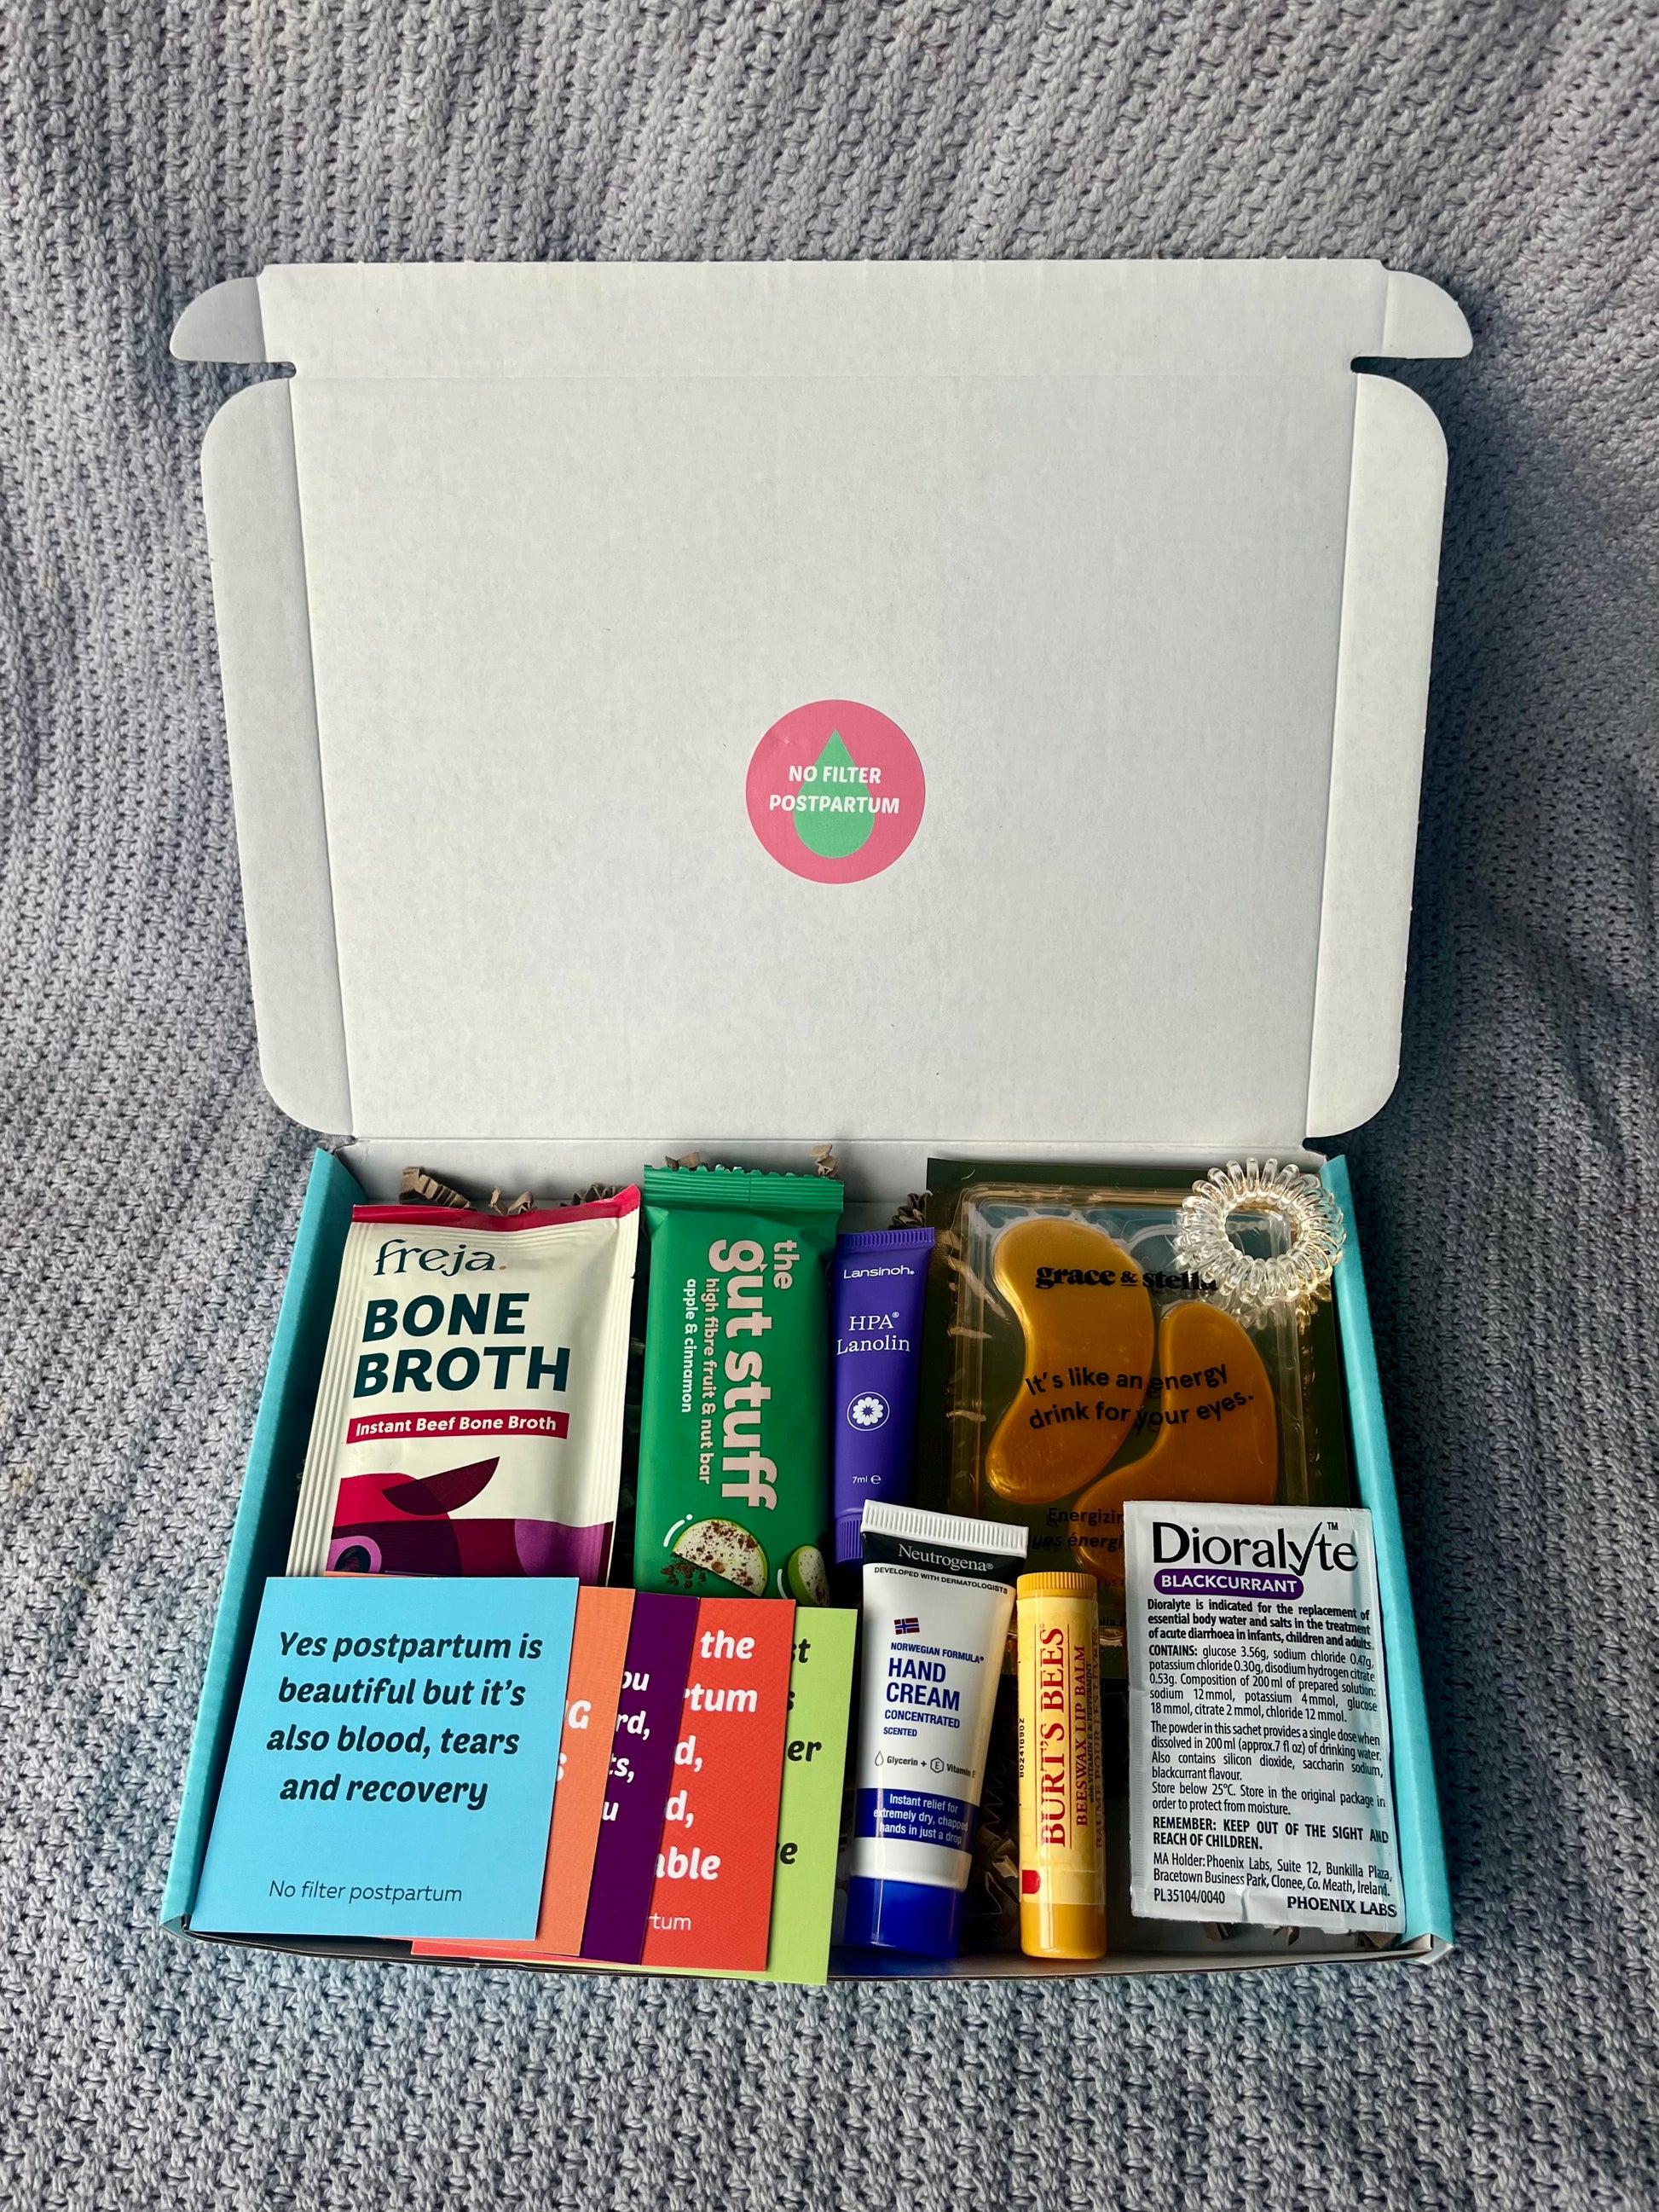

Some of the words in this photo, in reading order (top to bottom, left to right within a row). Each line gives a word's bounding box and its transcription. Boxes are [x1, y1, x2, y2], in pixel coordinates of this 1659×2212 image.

[789, 766, 817, 782] NO
[823, 766, 882, 784] FILTER
[769, 794, 899, 814] POSTPARTUM
[773, 1240, 800, 1289] the
[708, 1239, 772, 1339] gut
[1035, 1266, 1115, 1289] grace
[1120, 1271, 1137, 1287] &
[1142, 1271, 1219, 1291] stella
[682, 1278, 698, 1320] apple
[699, 1278, 720, 1313] high
[362, 1293, 529, 1343] BONE
[685, 1323, 697, 1334] &
[702, 1316, 720, 1357] fibre
[836, 1335, 910, 1356] Lanolin
[353, 1346, 570, 1398] BROTH
[682, 1337, 697, 1413] cinnamon
[702, 1359, 718, 1398] fruit
[1025, 1371, 1063, 1396] It's
[1068, 1367, 1109, 1387] like
[1116, 1373, 1142, 1389] an
[1151, 1364, 1228, 1392] energy
[701, 1403, 716, 1416] &
[1029, 1402, 1090, 1429] drink
[1095, 1401, 1130, 1422] for
[1136, 1408, 1188, 1429] your
[1197, 1391, 1253, 1421] eyes.
[356, 1421, 412, 1437] Instant
[416, 1417, 455, 1432] Beef
[460, 1416, 503, 1430] Bone
[508, 1416, 557, 1431] Broth
[699, 1419, 714, 1450] nut
[721, 1350, 777, 1511] stuff
[699, 1454, 714, 1485] bar
[853, 1475, 868, 1484] 7ml
[875, 1566, 919, 1578] DEVELOPED
[941, 1577, 1008, 1594] DERMATOLOGISTS
[1161, 1574, 1297, 1593] BLACKCURRANT
[1147, 1599, 1190, 1611] Dioralyte
[1195, 1600, 1204, 1610] is
[1209, 1600, 1252, 1612] indicated
[1257, 1602, 1272, 1613] for
[1277, 1603, 1292, 1614] the
[1298, 1607, 1356, 1619] replacement
[1361, 1610, 1369, 1620] of
[1147, 1613, 1189, 1624] essential
[1193, 1613, 1217, 1627] body
[1219, 1617, 1246, 1625] water
[1250, 1617, 1267, 1627] and
[1270, 1617, 1292, 1628] salts
[1295, 1618, 1304, 1629] in
[1307, 1618, 1323, 1630] the
[1326, 1621, 1370, 1635] treatment
[280, 1631, 327, 1656] Yes
[332, 1634, 511, 1663] postpartum
[518, 1633, 543, 1659] is
[701, 1630, 754, 1659] the
[891, 1642, 939, 1655] NORWEGIAN
[1148, 1628, 1159, 1638] of
[1159, 1629, 1186, 1639] acute
[1188, 1629, 1234, 1639] diarrhoea
[1237, 1630, 1246, 1640] in
[1247, 1630, 1284, 1642] infants,
[1286, 1632, 1323, 1644] children
[1327, 1635, 1344, 1646] and
[1345, 1636, 1374, 1651] adults.
[888, 1658, 946, 1682] HAND
[1149, 1645, 1197, 1656] CONTAINS:
[1203, 1645, 1236, 1659] glucose
[1241, 1647, 1269, 1660] 3.56g,
[1274, 1648, 1306, 1660] sodium
[1311, 1650, 1346, 1663] chloride
[1350, 1653, 1373, 1669] 0.47g,
[1074, 1645, 1085, 1698] BALM
[278, 1677, 416, 1705] beautiful
[423, 1679, 476, 1705] but
[480, 1679, 526, 1706] it's
[887, 1682, 960, 1711] CREAM
[885, 1710, 960, 1728] CONCENTRATED
[1075, 1702, 1086, 1732] LIP
[267, 1724, 329, 1751] also
[337, 1725, 431, 1759] blood,
[441, 1728, 520, 1755] tears
[883, 1727, 917, 1736] SCENTED
[887, 1756, 918, 1766] Glycerin
[947, 1763, 970, 1776] Vitamin
[1153, 1766, 1206, 1779] blackcurrant
[1209, 1768, 1242, 1781] flavour.
[280, 1774, 341, 1801] and
[346, 1780, 488, 1810] recovery
[1040, 1723, 1066, 1848] BURT'S
[1076, 1738, 1088, 1827] BEESWAX
[889, 1794, 921, 1806] Instant
[923, 1799, 945, 1810] relief
[948, 1803, 958, 1814] for
[873, 1810, 916, 1822] extremely
[919, 1813, 935, 1825] dry,
[938, 1816, 968, 1832] chapped
[880, 1824, 906, 1834] hands
[909, 1825, 917, 1835] in
[919, 1825, 936, 1839] just
[939, 1831, 943, 1839] a
[946, 1832, 962, 1844] drop
[1153, 1816, 1217, 1831] REMEMBER:
[1223, 1819, 1250, 1833] KEEP
[1257, 1821, 1278, 1834] OUT
[1286, 1822, 1298, 1835] OF
[1305, 1824, 1327, 1838] THE
[1332, 1826, 1363, 1840] SIGHT
[1370, 1829, 1389, 1843] AND
[1153, 1833, 1187, 1845] REACH
[1190, 1833, 1203, 1846] OF
[1206, 1834, 1263, 1850] CHILDREN.
[1153, 1852, 1169, 1865] MA
[1171, 1853, 1205, 1867] Holder:
[1207, 1855, 1244, 1868] Phoenix
[1249, 1856, 1272, 1872] Labs,
[1278, 1859, 1301, 1873] Suite
[1307, 1862, 1321, 1875] 12,
[1327, 1862, 1363, 1877] Bunkilla
[1368, 1865, 1392, 1882] Plaza,
[269, 1880, 296, 1897] No
[301, 1881, 346, 1899] filter
[350, 1884, 462, 1905] postpartum
[1153, 1868, 1202, 1883] Bracetown
[1205, 1871, 1244, 1885] Business
[1246, 1873, 1269, 1888] Park,
[1272, 1875, 1304, 1891] Clonee,
[1308, 1878, 1320, 1890] Co.
[1323, 1879, 1355, 1894] Meath,
[1358, 1880, 1390, 1896] Ireland.
[1154, 1888, 1225, 1903] PL35104/0040
[1287, 1896, 1356, 1914] PHOENIX
[1360, 1902, 1397, 1918] LABS
